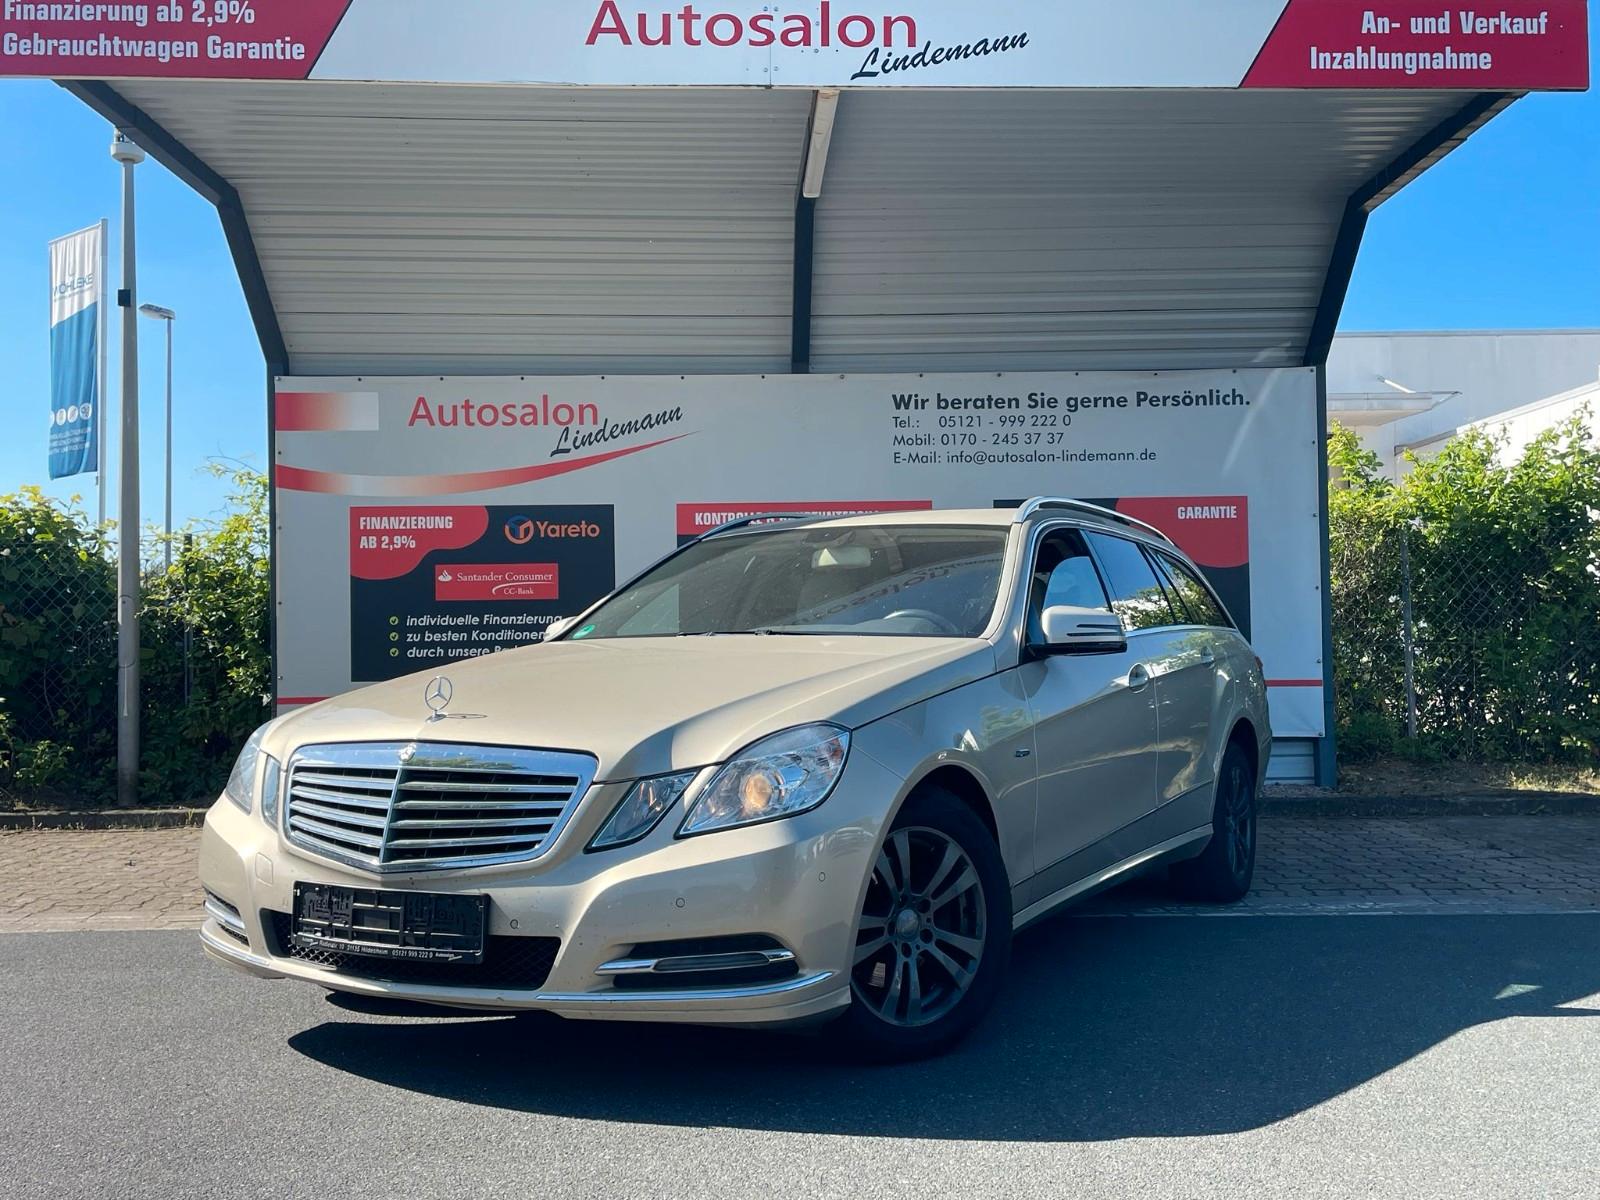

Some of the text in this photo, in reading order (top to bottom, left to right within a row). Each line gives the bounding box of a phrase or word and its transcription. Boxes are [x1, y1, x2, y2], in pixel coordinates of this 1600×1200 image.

[4, 0, 255, 27] Finanzierung ab 2,9%
[585, 0, 917, 48] Autosalon
[1361, 11, 1548, 34] An- und Verkauf
[3, 33, 305, 63] Gebrauchtwagen Garantie
[850, 31, 1029, 81] Lindemann
[1310, 46, 1492, 74] Inzahlungnahme
[892, 389, 1250, 412] Wir beraten Sie gerne Persönlich.
[408, 395, 599, 427] Autosalon
[893, 416, 920, 429] Tel.:
[938, 416, 982, 428] 05121
[999, 415, 1026, 428] 999
[1031, 415, 1057, 427] 222
[1062, 415, 1072, 427] 0
[550, 406, 683, 457] Lindemann
[893, 433, 935, 446] Mobil:
[941, 433, 977, 446] 0170
[992, 433, 1019, 446] 245
[1024, 433, 1041, 445] 37
[1047, 432, 1064, 445] 37
[893, 448, 1157, 465] E-Mail: info@autosalon-lindemann.de
[695, 511, 763, 526] KONTR
[1177, 505, 1237, 520] GARANTIE
[359, 516, 454, 531] FINANZIERUNG
[536, 520, 600, 539] Yareto
[359, 535, 416, 551] AB 2,9%
[456, 571, 553, 582] Santander Consumer
[503, 586, 534, 596] CC-Bank
[406, 614, 480, 627] individuelle
[406, 629, 546, 642] zu besten Konditionen
[406, 646, 443, 658] durch
[447, 646, 490, 658] unsere
